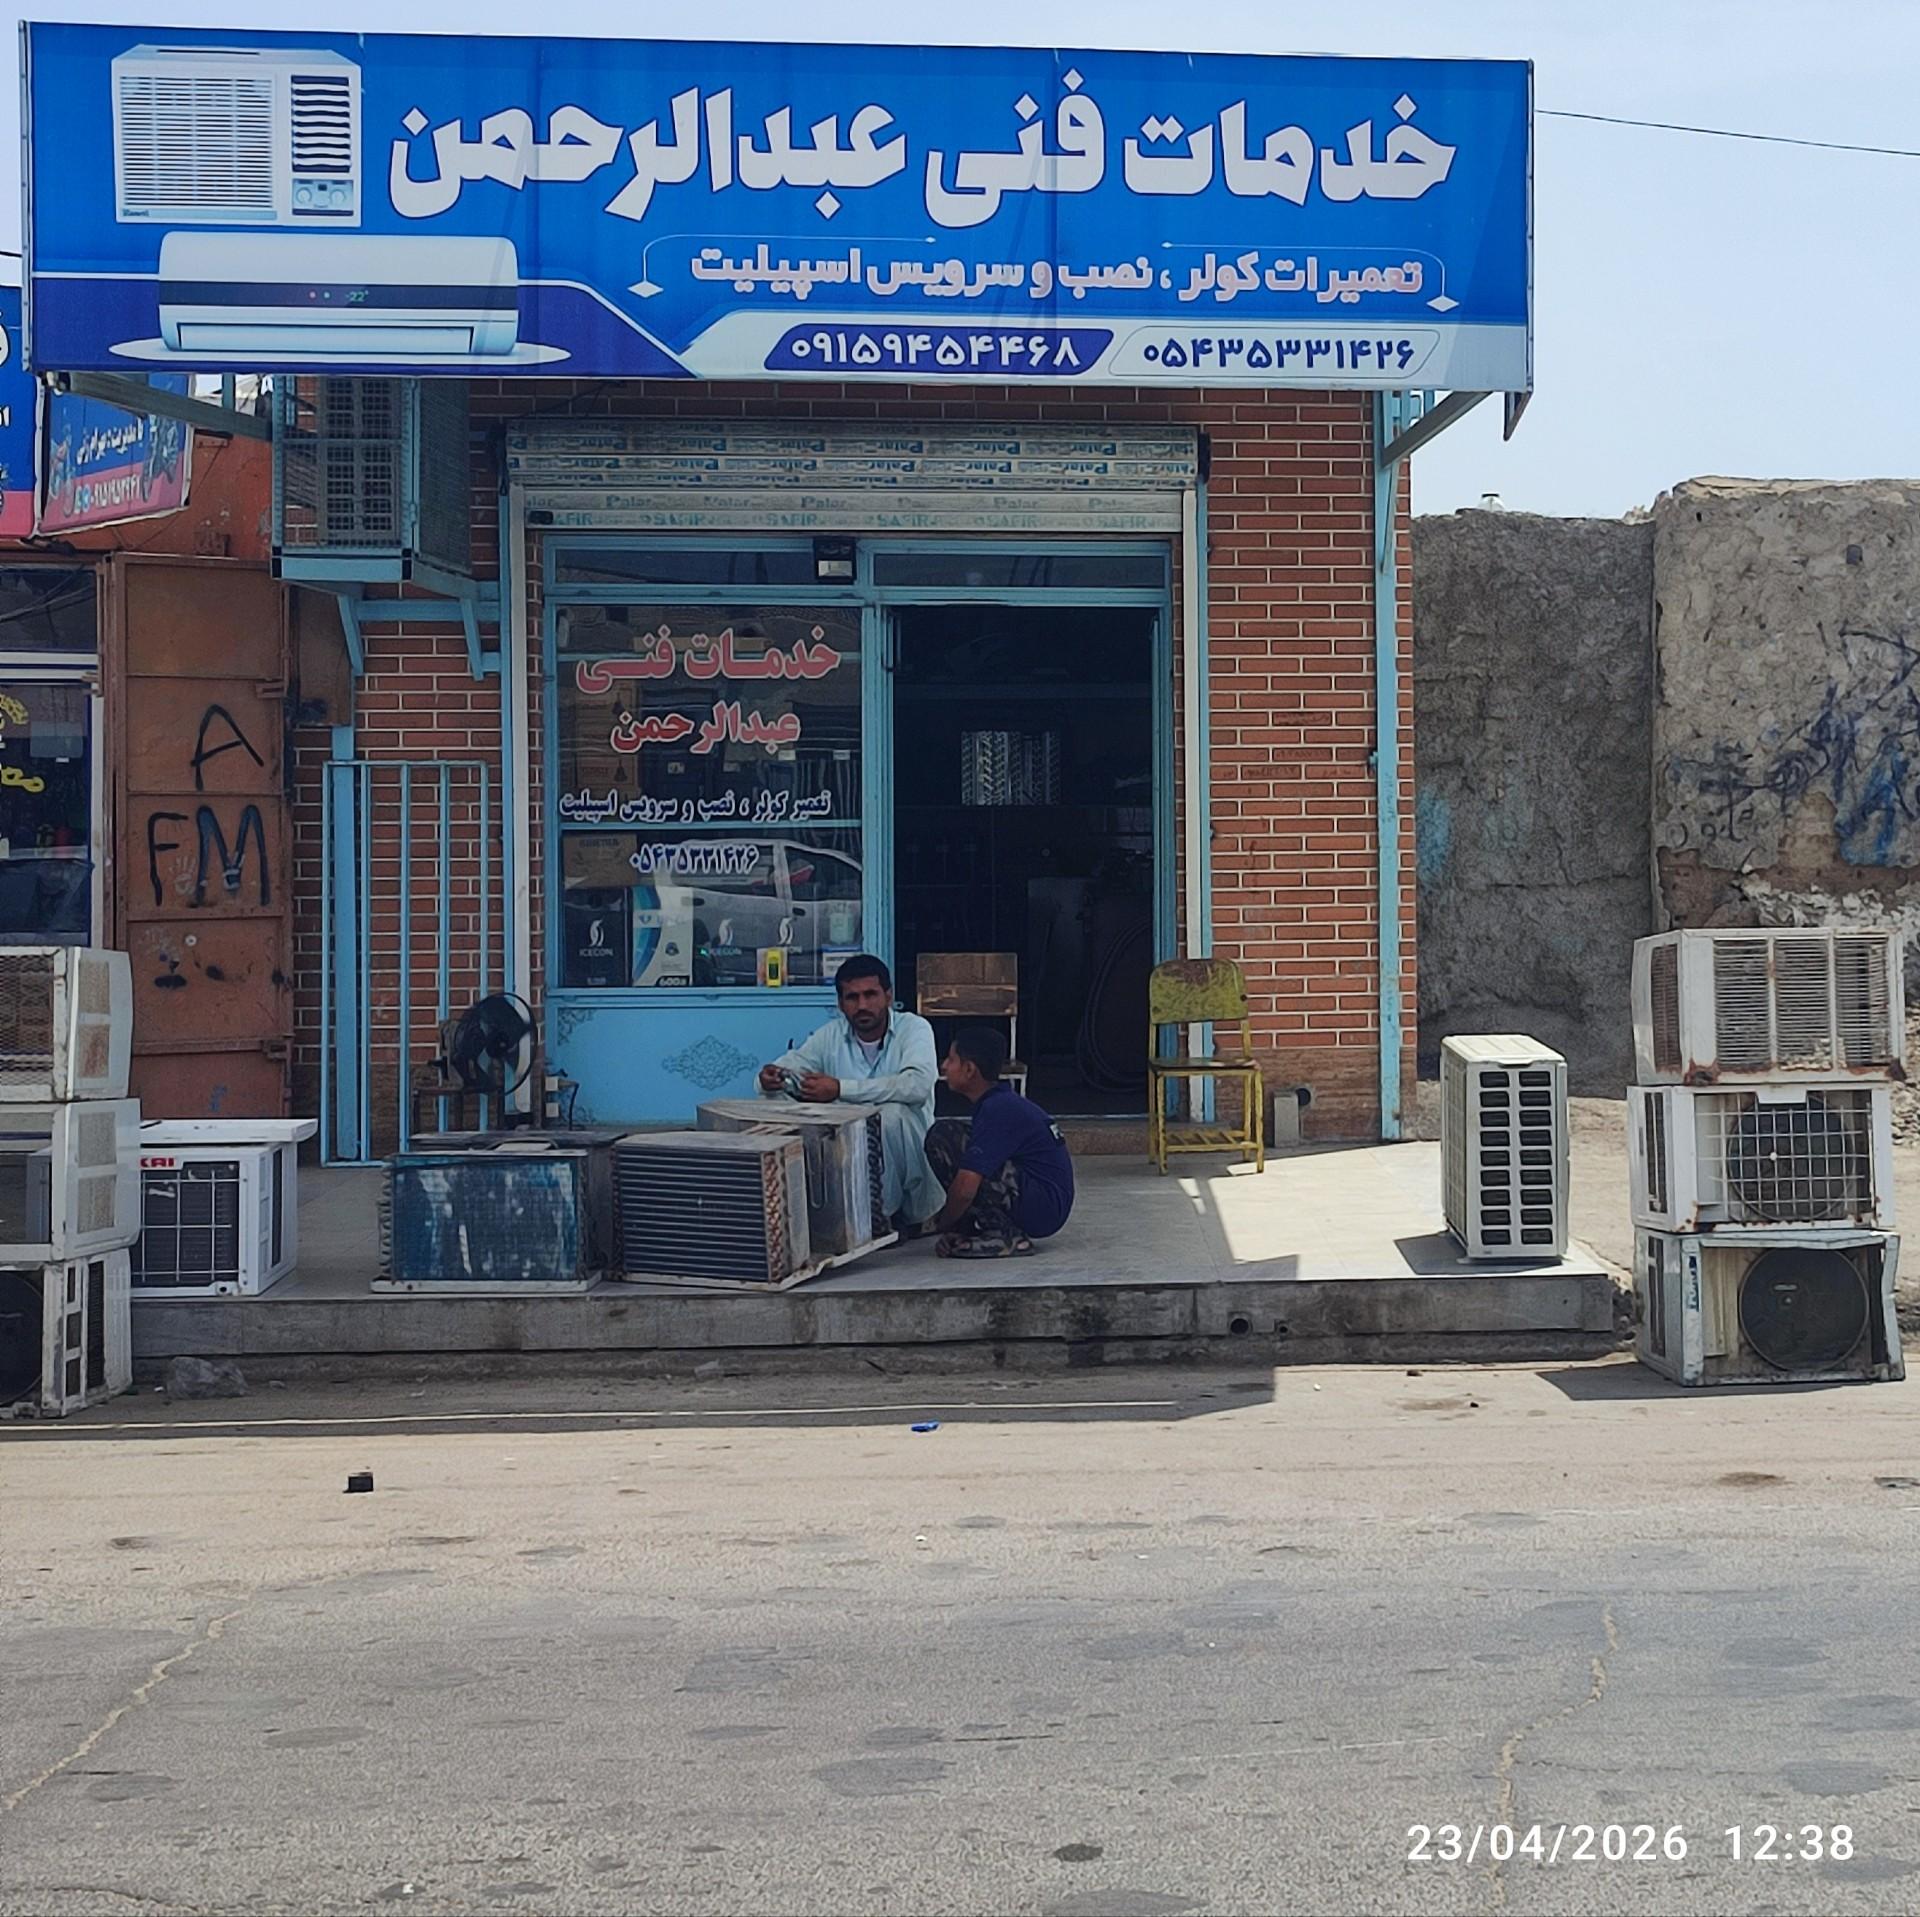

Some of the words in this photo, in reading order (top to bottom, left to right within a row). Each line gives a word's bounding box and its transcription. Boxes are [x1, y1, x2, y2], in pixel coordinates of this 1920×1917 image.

[389, 86, 906, 222] عبدالرحمن
[924, 67, 1106, 228] فنی
[1124, 94, 1457, 206] خدمات
[691, 244, 861, 300] اسپیلیت
[866, 258, 1025, 297] سرویس
[1029, 260, 1053, 299] و
[1058, 256, 1153, 299] نصب
[1178, 251, 1260, 302] کولر
[1264, 256, 1423, 304] تعمیرات
[791, 332, 1081, 367] ۰۹۱۵۹۴۵۴۴۶۸
[1143, 338, 1415, 370] ۰۵۴۳۵۳۳۱۴۲۶
[576, 624, 676, 694] فنی
[684, 625, 841, 679] خدمات
[610, 700, 801, 753] عبدالرحمن
[620, 795, 678, 823] سرویس
[680, 799, 694, 823] و
[698, 789, 735, 822] نصب
[752, 789, 789, 823] کولر
[789, 790, 831, 821] تعمیر
[629, 843, 760, 874] ۰۵۴۳۵۳۳۱۴۲۶
